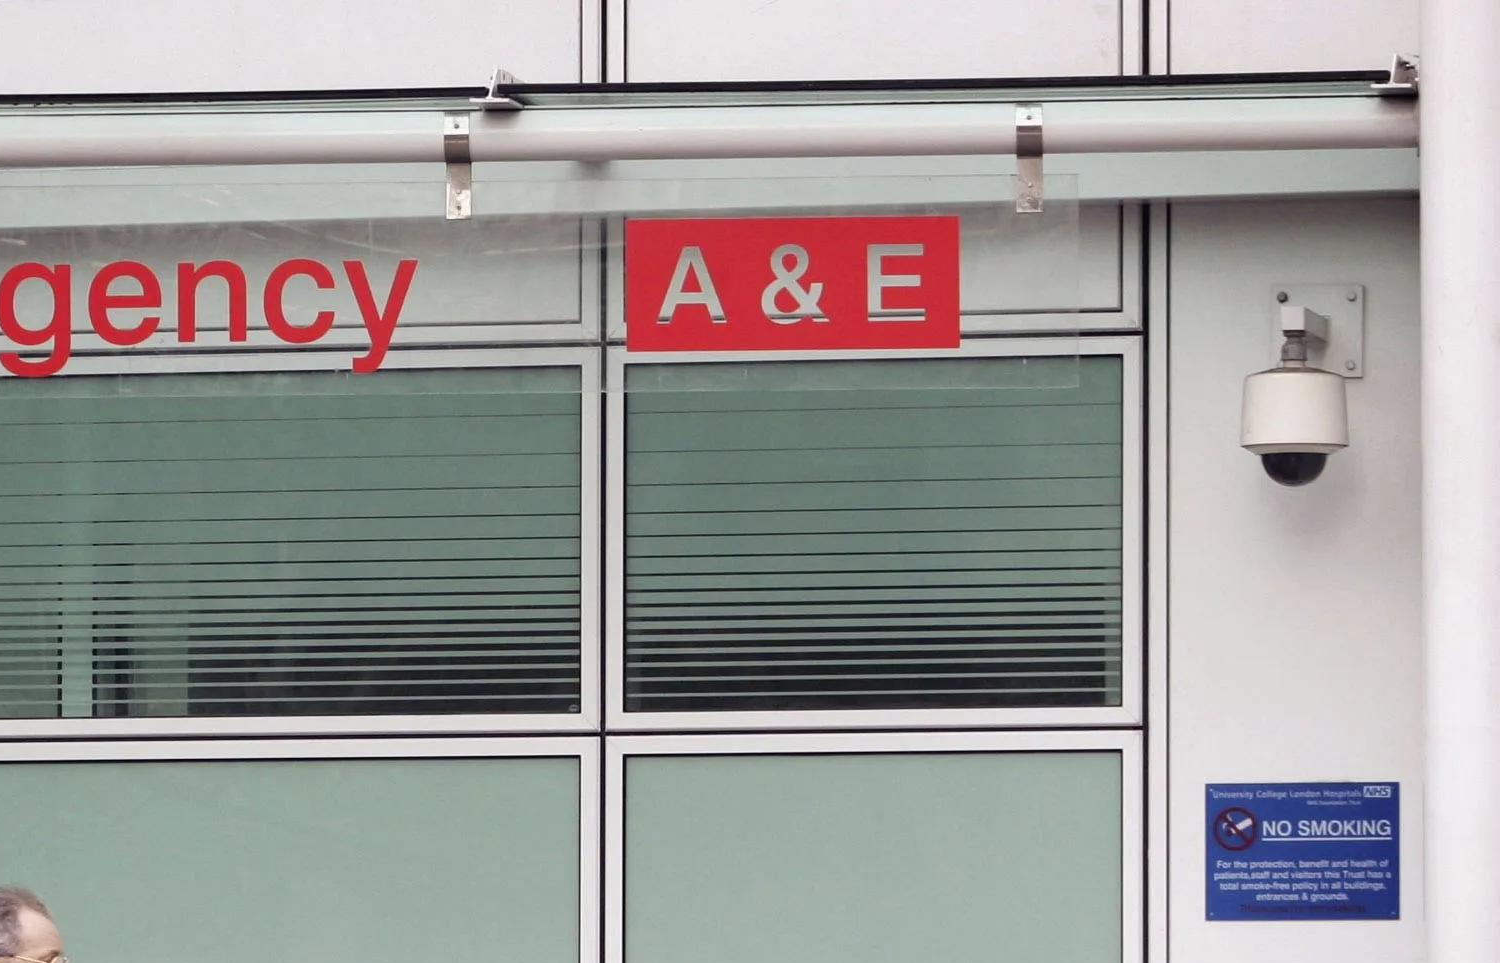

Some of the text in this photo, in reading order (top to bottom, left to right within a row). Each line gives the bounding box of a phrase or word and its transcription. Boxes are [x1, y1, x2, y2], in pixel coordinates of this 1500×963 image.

[656, 243, 927, 325] A & E
[1212, 791, 1253, 800] University
[1256, 790, 1286, 800] College
[1364, 786, 1391, 797] NHS
[1262, 819, 1392, 836] NO SMOKING
[1216, 860, 1232, 869] For
[1233, 860, 1248, 868] the
[1299, 860, 1330, 868] benefit
[1331, 860, 1348, 868] and
[1350, 860, 1377, 868] health
[1379, 859, 1389, 867] of
[1272, 871, 1289, 879] and
[1324, 871, 1340, 879] this
[1342, 870, 1365, 879] Trust
[1367, 871, 1384, 879] has
[1220, 882, 1239, 890] total
[1292, 882, 1318, 891] policy
[1320, 881, 1329, 889] in
[1330, 881, 1341, 889] all
[1256, 893, 1299, 901] entrances
[1301, 892, 1308, 900] &
